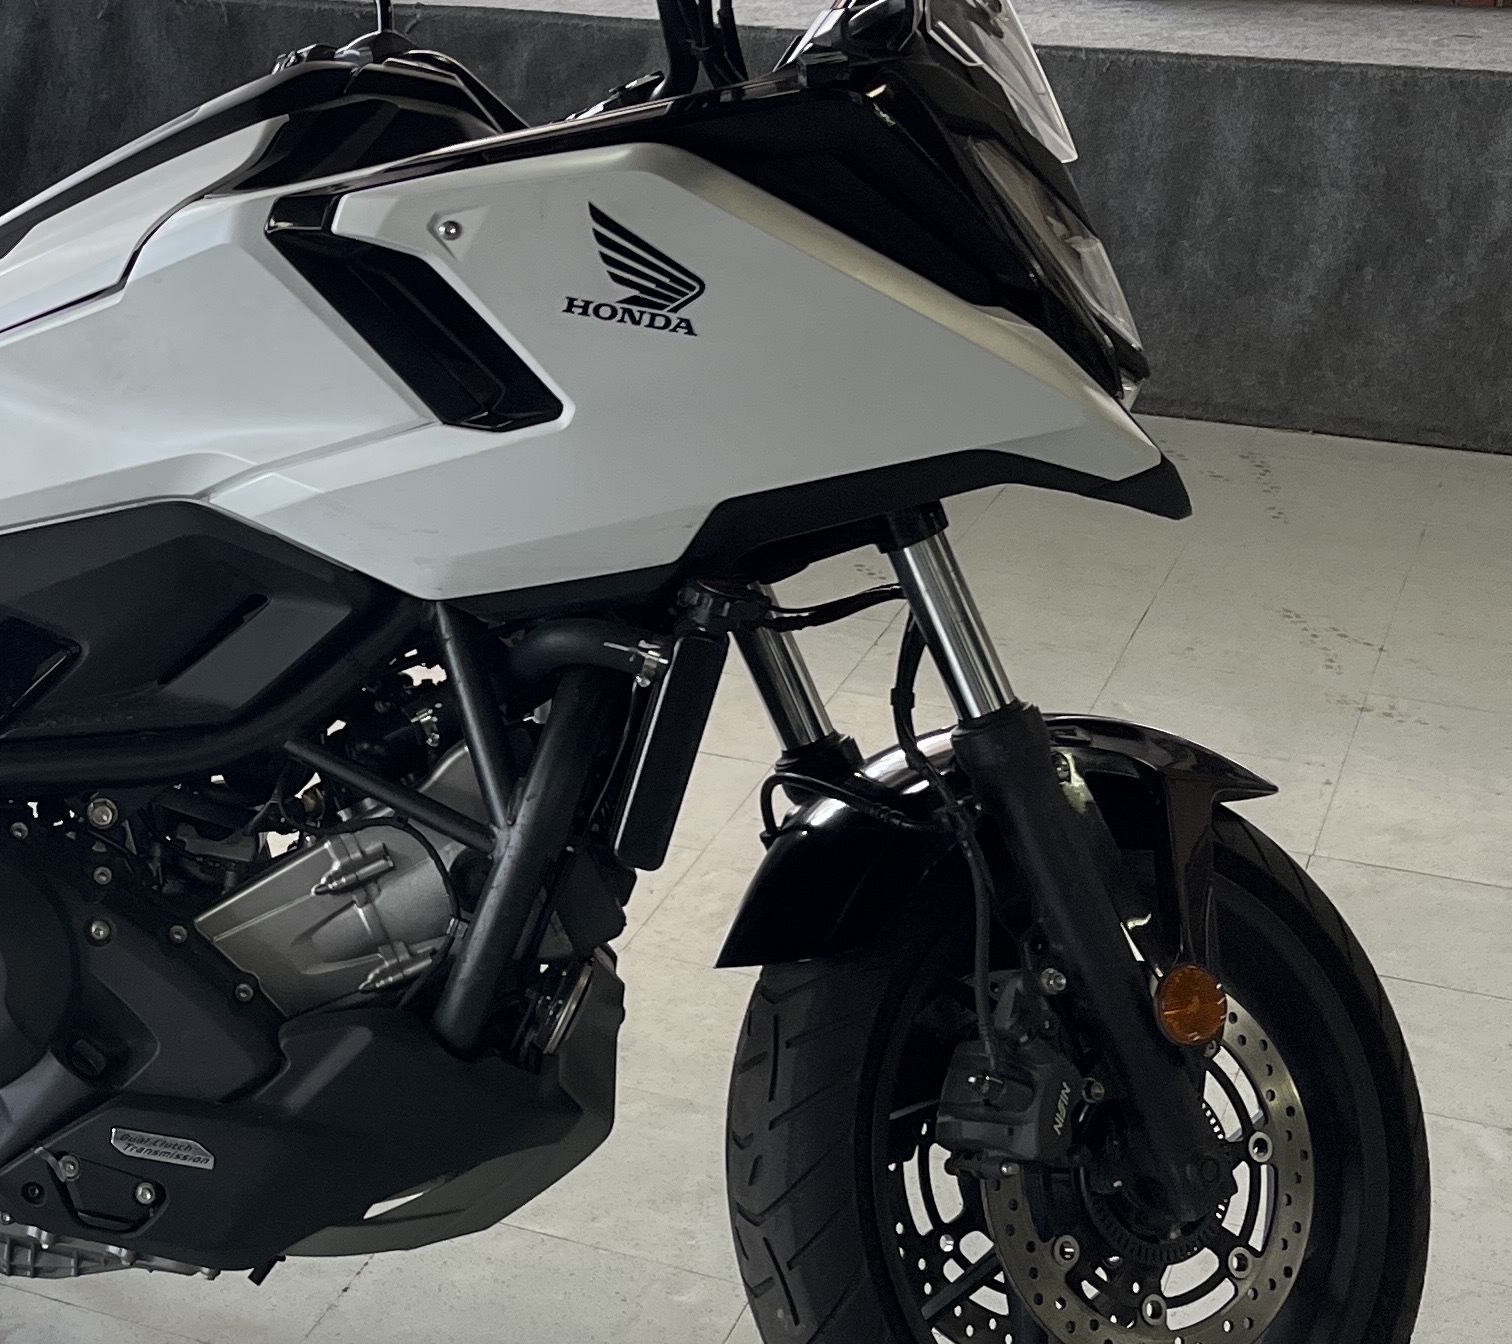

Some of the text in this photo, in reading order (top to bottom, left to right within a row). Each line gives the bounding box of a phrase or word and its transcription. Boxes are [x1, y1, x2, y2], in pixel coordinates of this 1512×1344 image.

[561, 296, 698, 337] HONDA
[119, 1133, 193, 1152] Dual Clutch
[123, 1142, 210, 1164] Transmission
